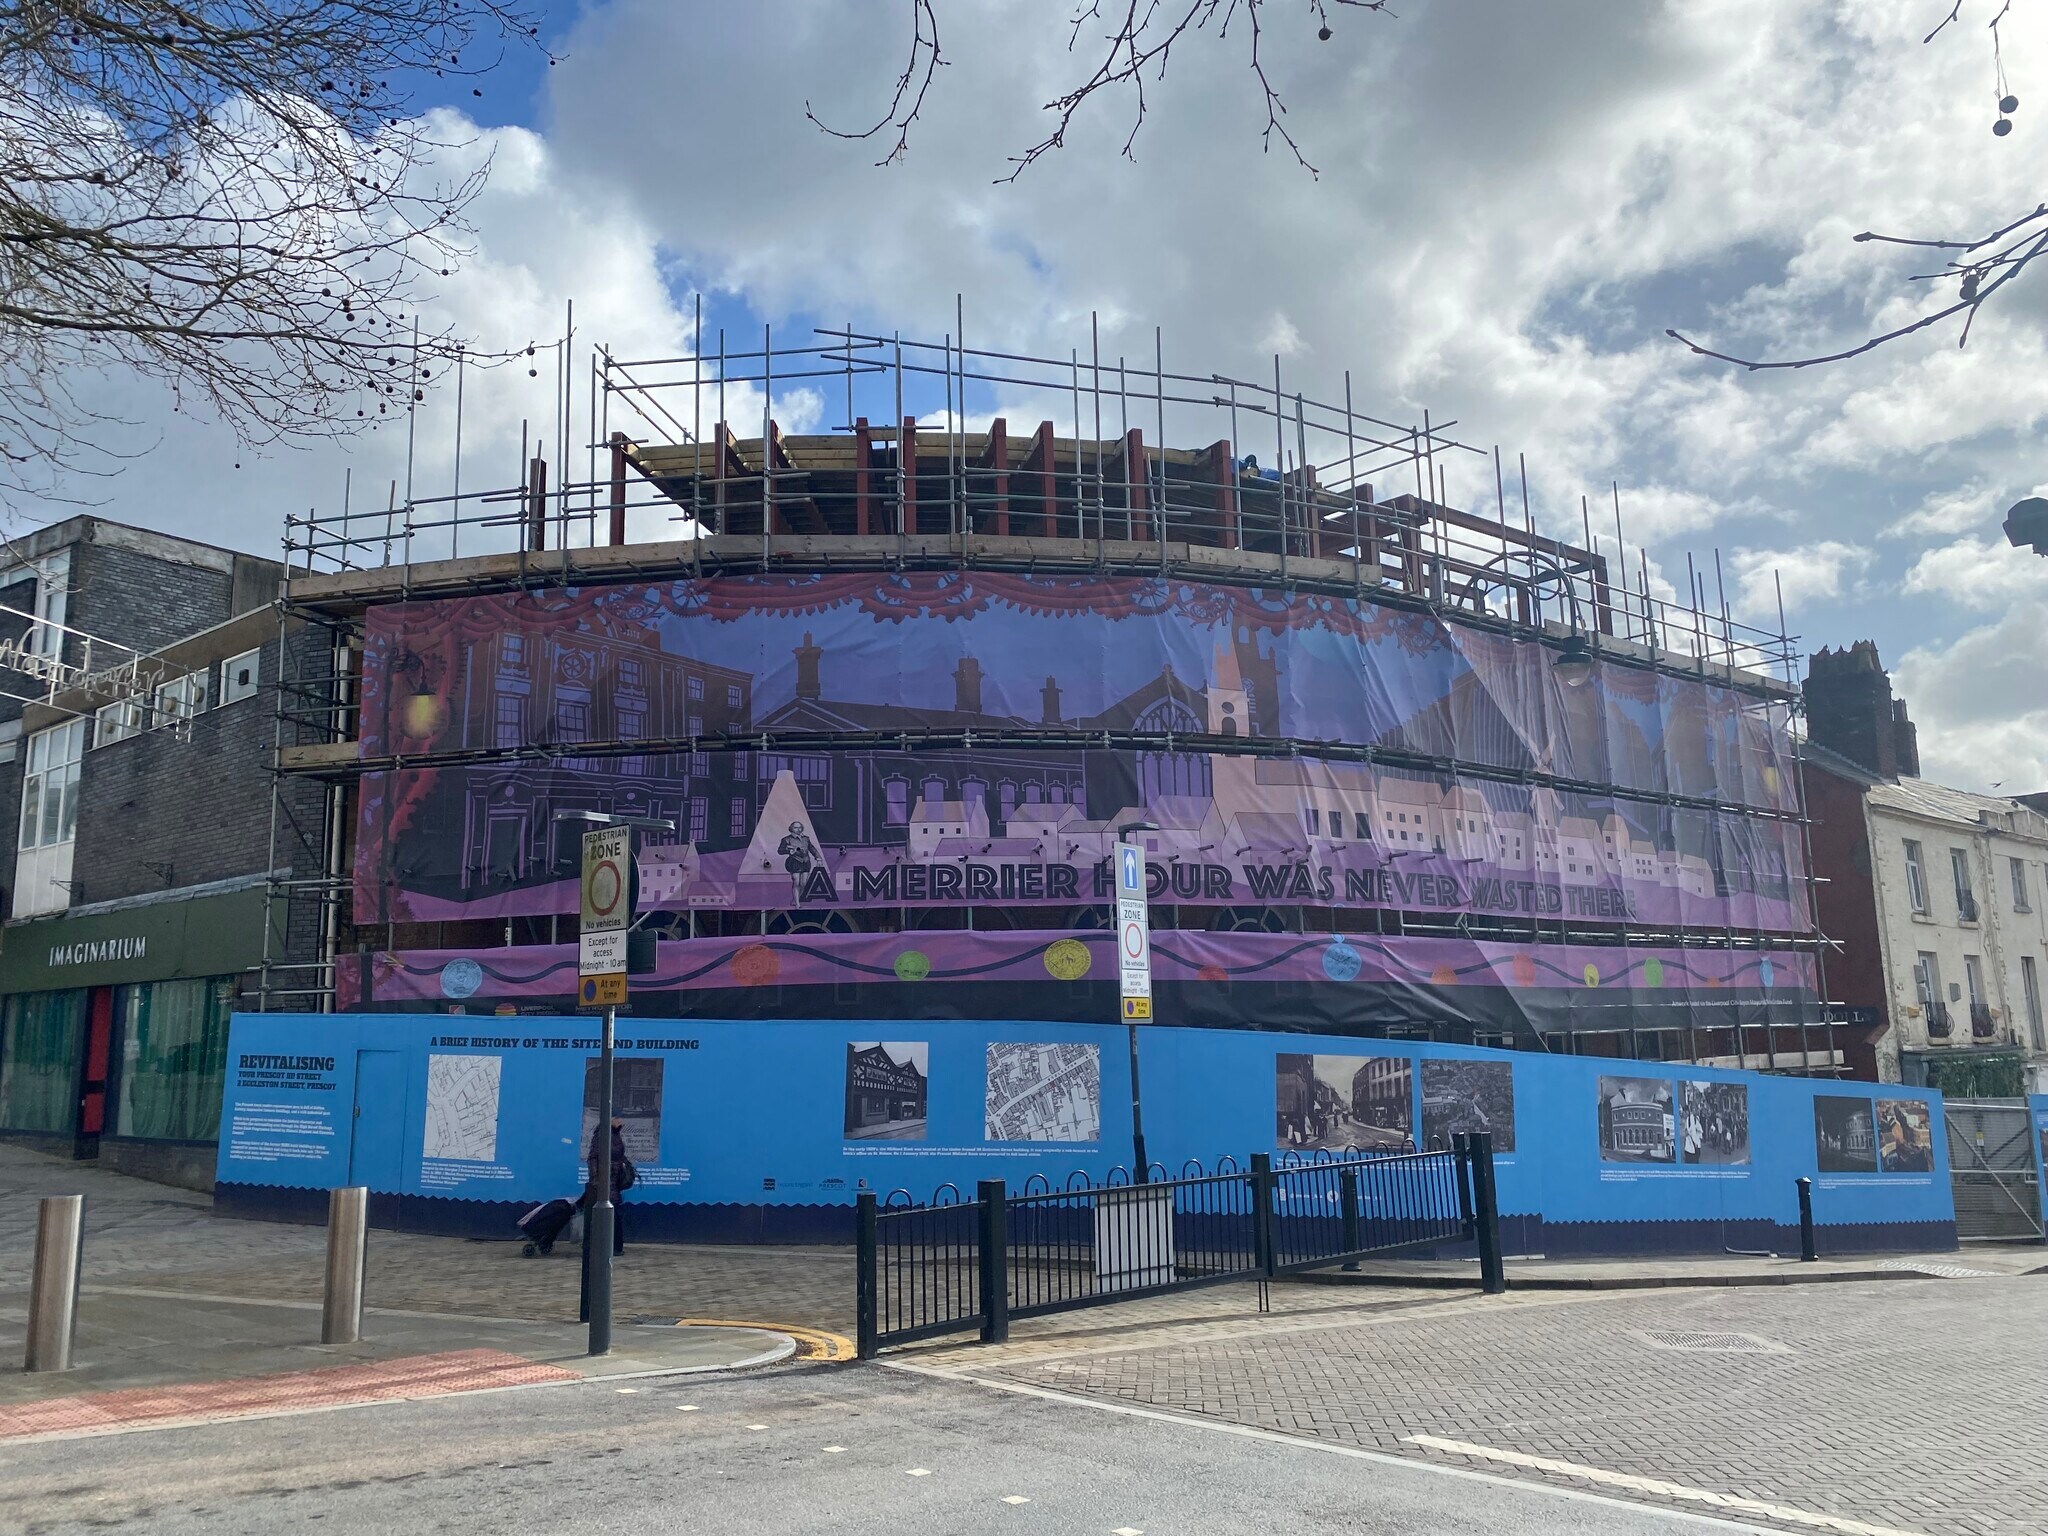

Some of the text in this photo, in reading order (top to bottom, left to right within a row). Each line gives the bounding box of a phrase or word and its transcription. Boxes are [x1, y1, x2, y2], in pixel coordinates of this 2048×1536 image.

[585, 829, 627, 844] PEDESTRIAN
[591, 842, 620, 860] ZONE
[800, 863, 1637, 917] A MERRIER HOUR WAS NEVER WASTED THERE
[1124, 910, 1141, 919] ZONE
[586, 918, 621, 929] No vehicles
[588, 936, 619, 947] Except for
[49, 936, 146, 967] IMAGINARIUM
[593, 949, 613, 957] access
[580, 961, 604, 971] Midnight
[601, 979, 621, 988] At any
[604, 990, 617, 999] time
[430, 1036, 700, 1050] A BRIEF HISTORY OF THE SITE ND BUILDING
[239, 1055, 335, 1071] REVITALISING
[257, 1071, 285, 1079] PRESCOT
[242, 1080, 279, 1088] ECCLESTON
